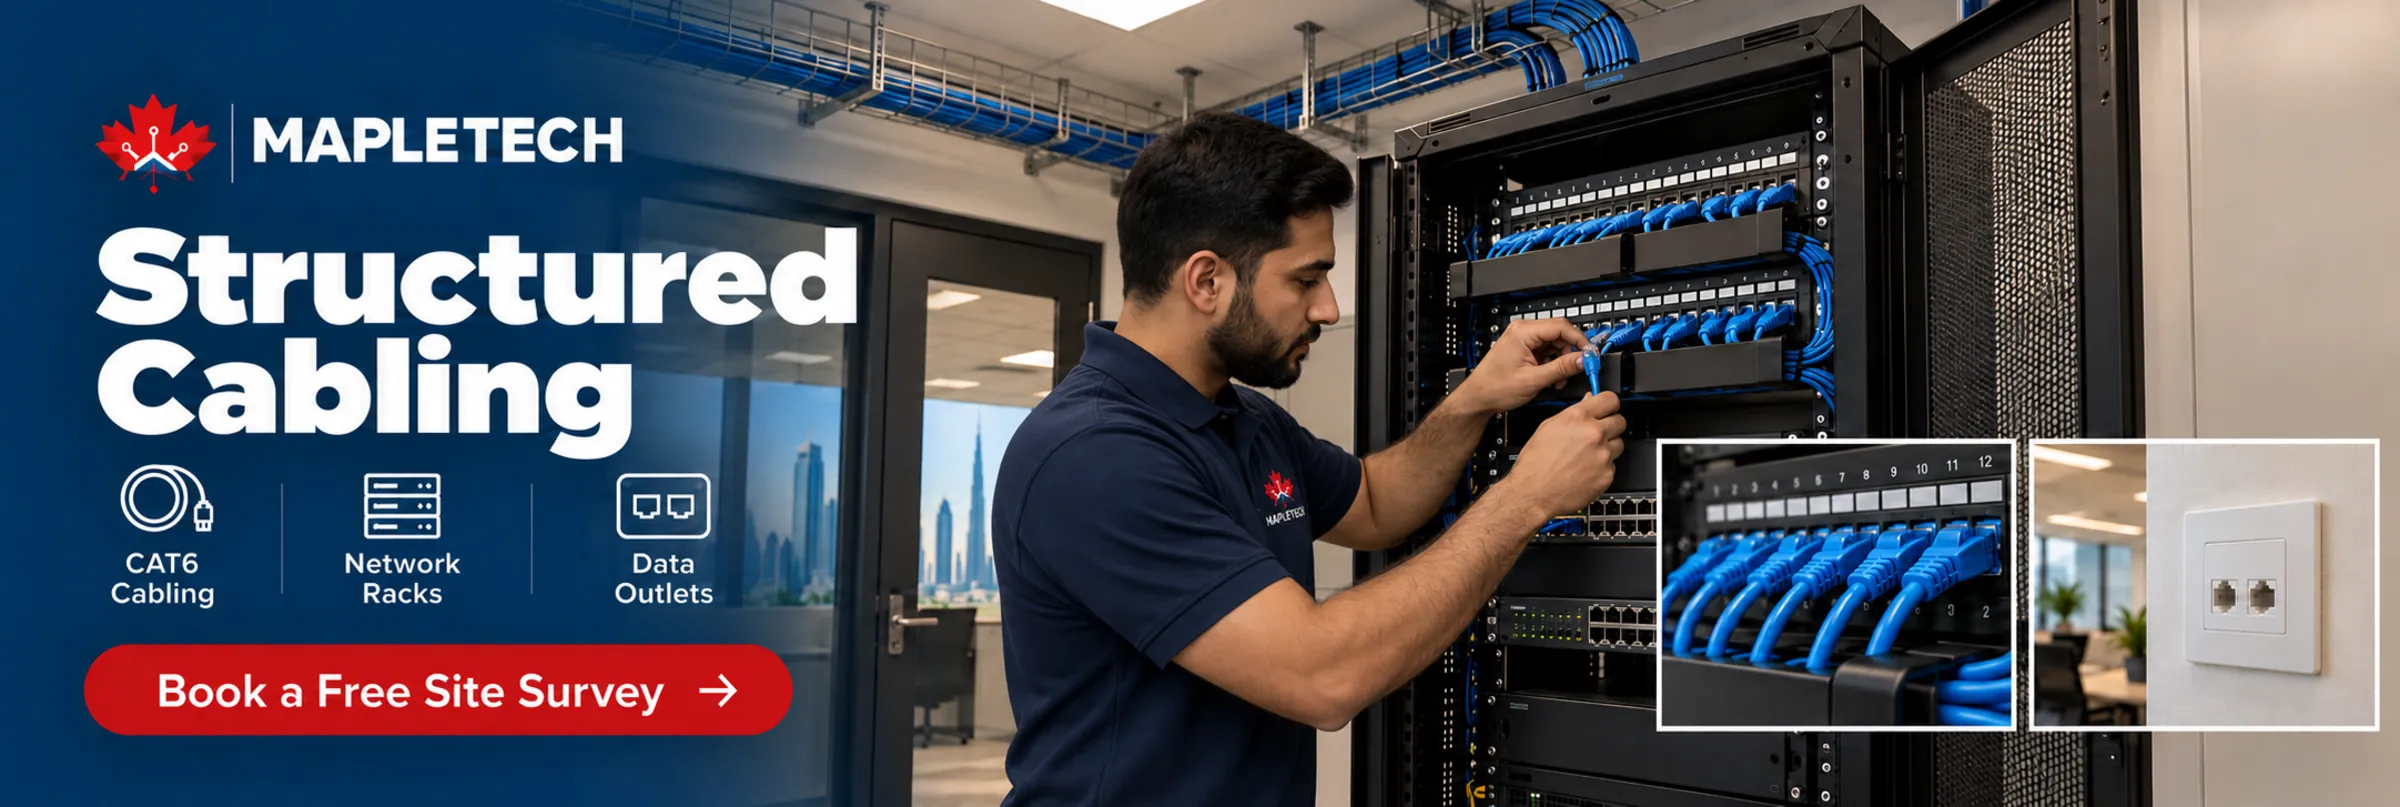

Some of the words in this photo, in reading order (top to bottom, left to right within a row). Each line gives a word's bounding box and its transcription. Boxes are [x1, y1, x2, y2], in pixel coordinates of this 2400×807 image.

[1751, 481, 1759, 493] 3
[1771, 480, 1779, 490] 4
[1793, 477, 1800, 488] 5
[1838, 472, 1846, 483] 7
[1862, 469, 1870, 480] 8
[1890, 466, 1898, 477] 9
[1916, 463, 1929, 475] 10
[1946, 458, 1958, 472] 11
[1978, 454, 1993, 468] 12
